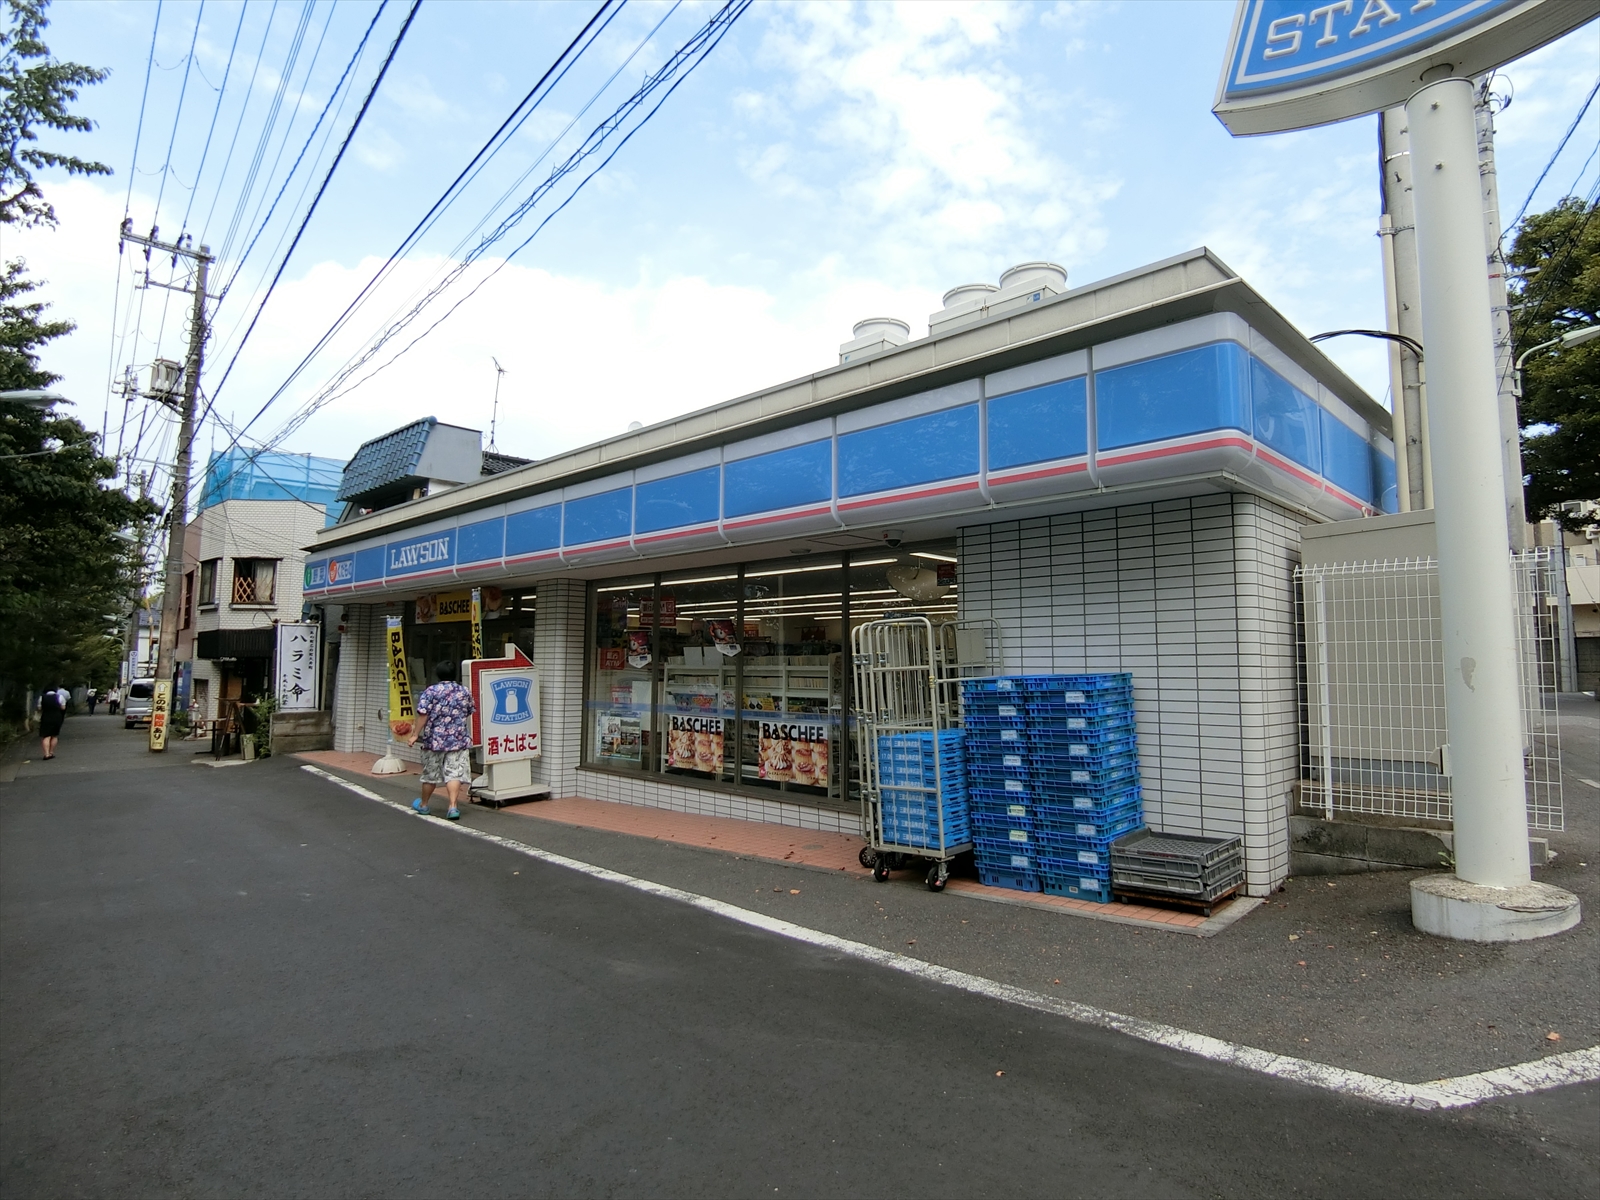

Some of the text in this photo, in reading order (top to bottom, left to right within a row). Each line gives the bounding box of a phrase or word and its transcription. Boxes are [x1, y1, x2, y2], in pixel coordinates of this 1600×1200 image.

[390, 537, 450, 570] LAWSON
[439, 599, 470, 615] BASCHEE
[287, 634, 311, 702] ハラミ命
[390, 631, 413, 717] BASCHEE
[494, 680, 529, 691] LAWSON
[495, 710, 529, 722] STATION
[672, 715, 721, 736] BASCHEE
[762, 722, 824, 744] BASCHEE
